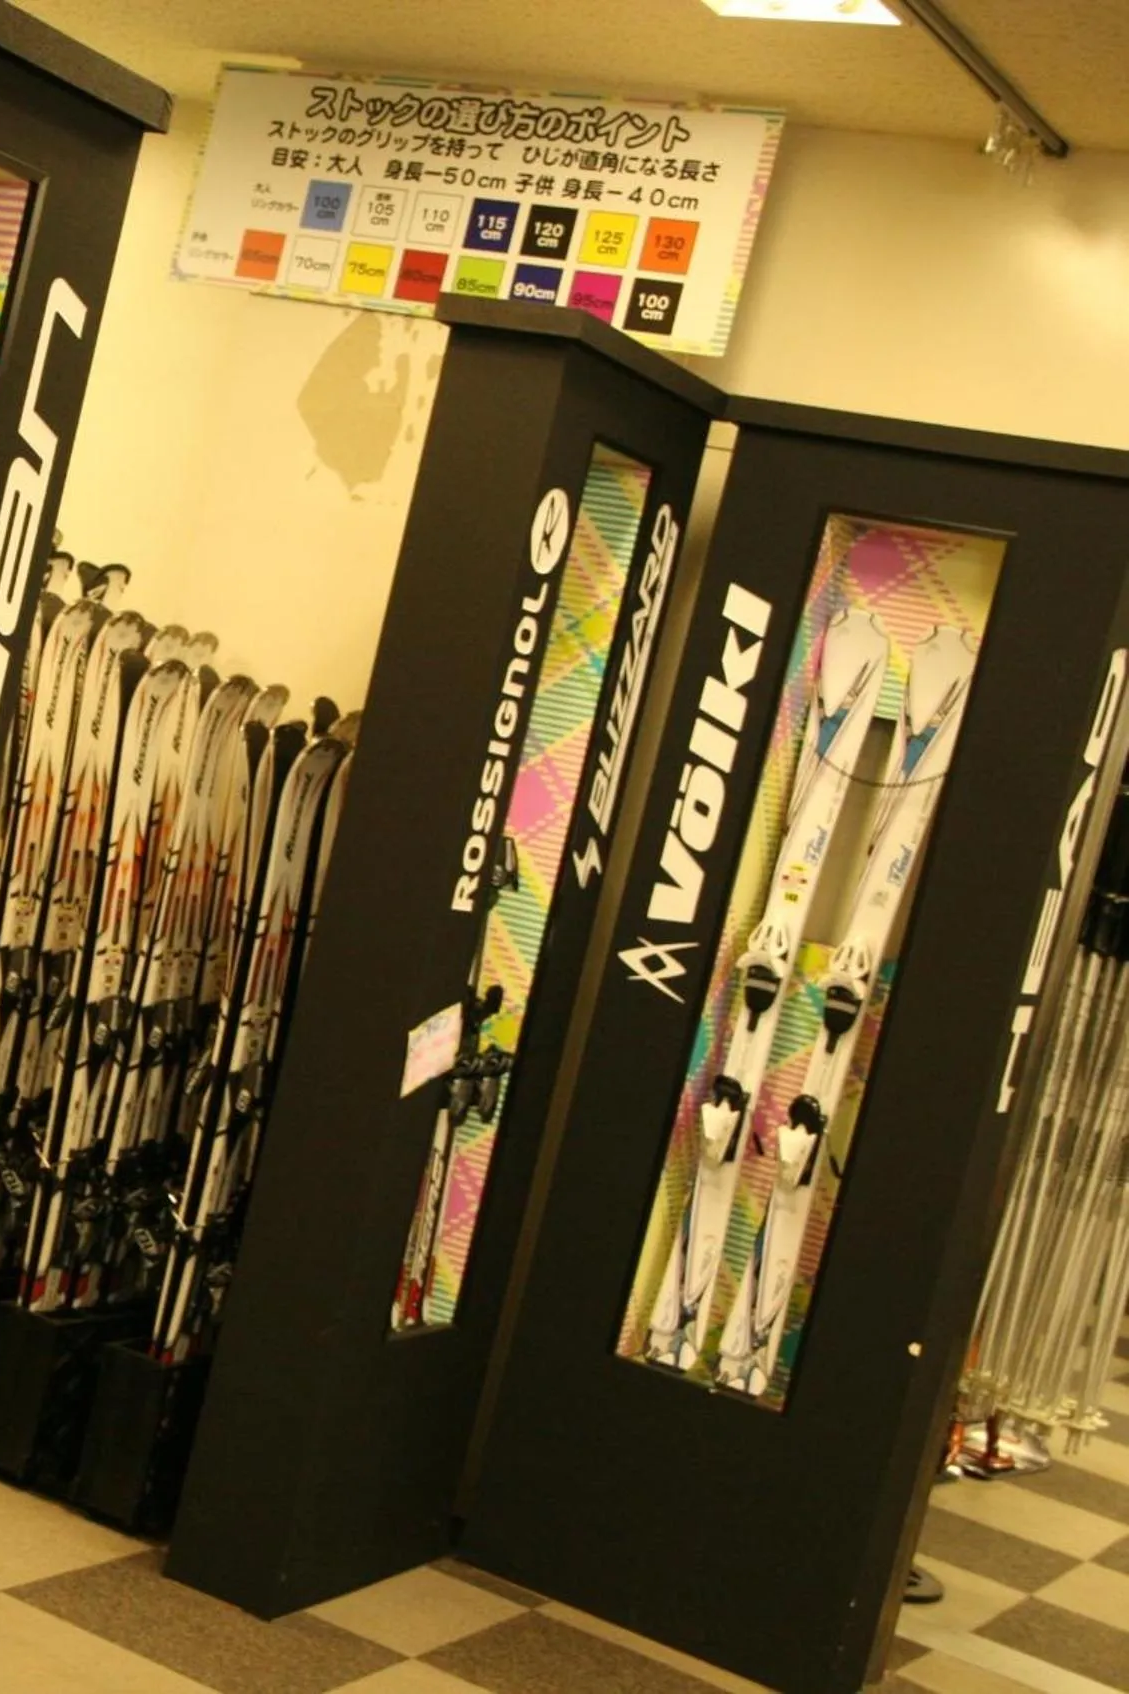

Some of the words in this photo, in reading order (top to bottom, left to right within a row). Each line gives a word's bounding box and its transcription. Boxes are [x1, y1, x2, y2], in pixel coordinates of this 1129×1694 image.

[305, 86, 691, 153] ストックの選び方のポイント
[267, 120, 504, 161] ストックのグリップを持って
[521, 144, 721, 183] ひじが直角になる長さ
[514, 172, 555, 197] 子供
[367, 201, 394, 216] 105
[421, 207, 450, 222] 110
[370, 216, 390, 227] cm
[425, 221, 446, 233] cm
[477, 213, 509, 230] 115
[533, 220, 565, 238] 120
[479, 229, 503, 242] cm
[536, 236, 560, 250] cm
[593, 229, 624, 246] 125
[654, 234, 686, 250] 130
[596, 244, 619, 256] cm
[657, 249, 680, 262] cm
[347, 262, 386, 278] 75cm
[456, 278, 497, 293] 85cm
[513, 282, 556, 301] 90cm
[637, 293, 670, 310] 100
[640, 309, 664, 321] cm
[589, 504, 678, 834] BLIZZARD
